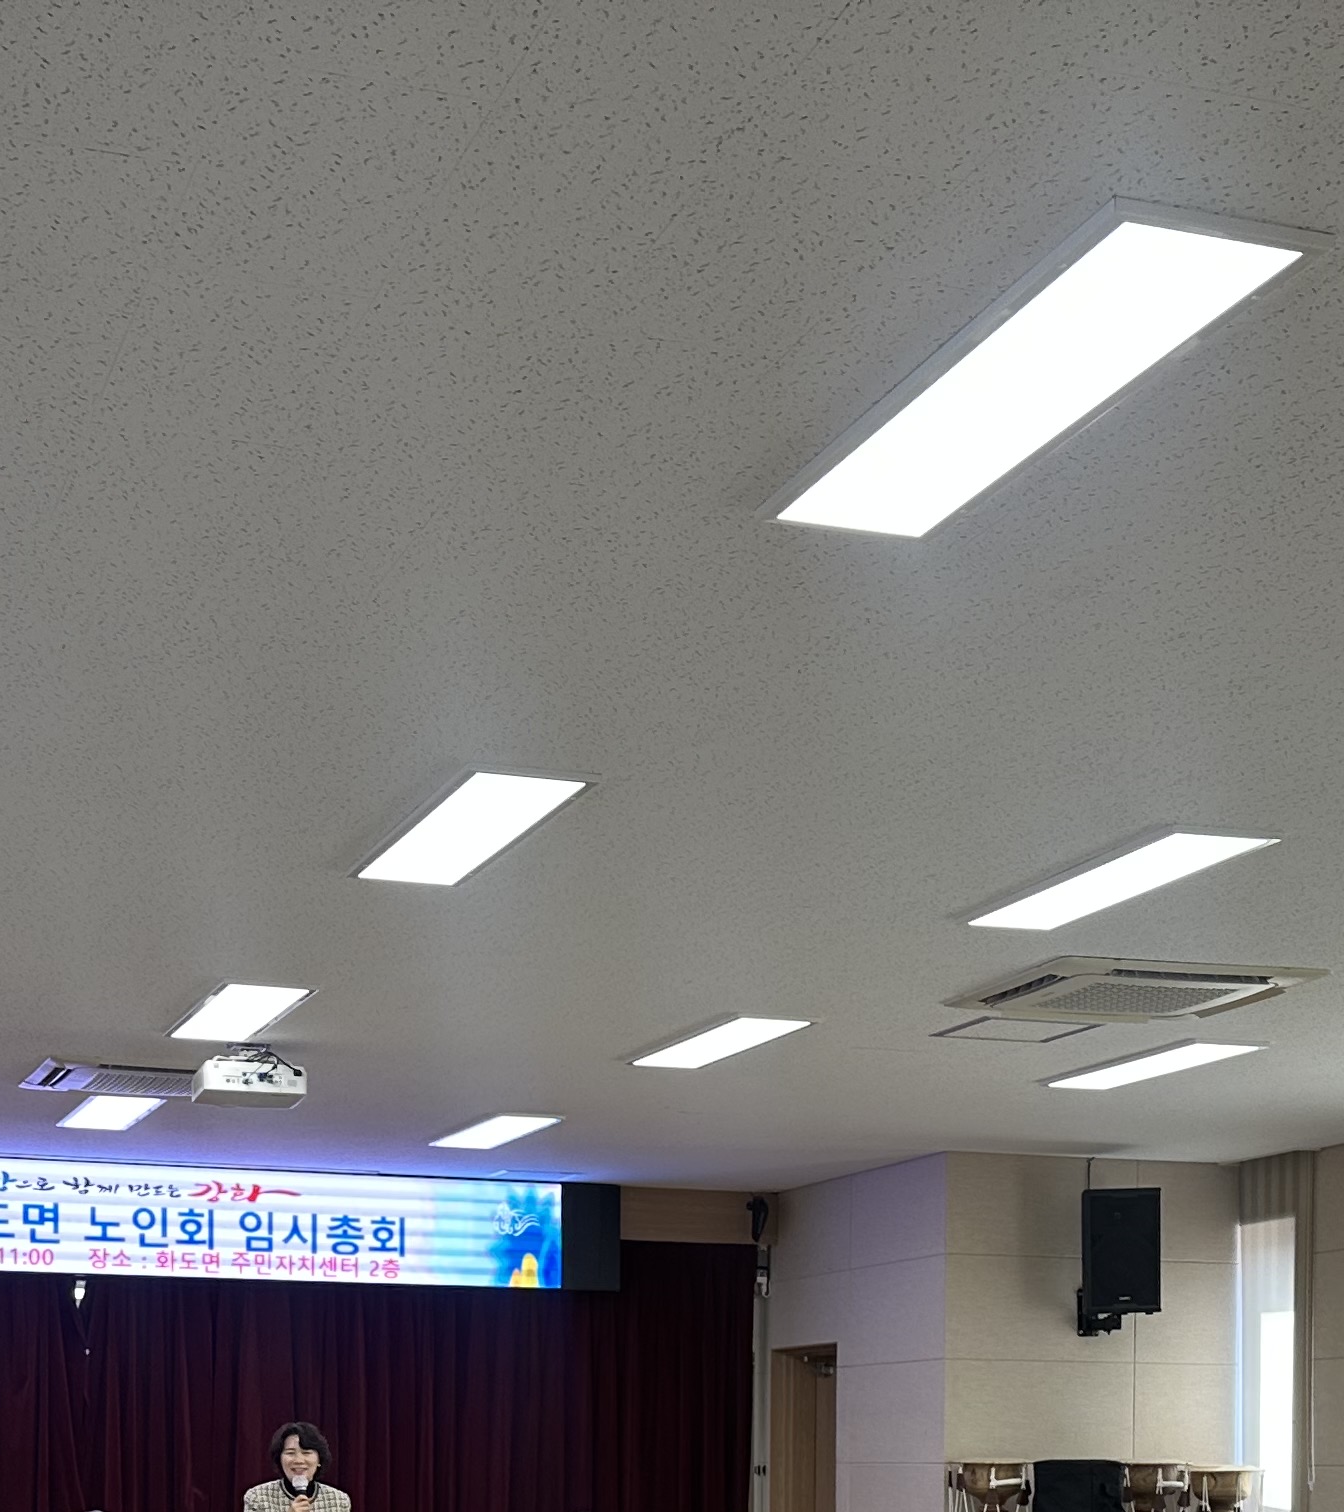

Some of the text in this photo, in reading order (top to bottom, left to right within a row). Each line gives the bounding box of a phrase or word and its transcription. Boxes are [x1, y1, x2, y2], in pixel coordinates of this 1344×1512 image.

[63, 1177, 119, 1195] 함께
[128, 1183, 181, 1198] 만드는
[188, 1180, 302, 1203] 강화
[84, 1206, 214, 1251] 노인회
[239, 1211, 406, 1258] 임시총회
[88, 1248, 134, 1270] 장소
[156, 1250, 221, 1274] 화도면
[231, 1252, 359, 1278] 주민자치센터
[369, 1259, 401, 1279] 2층
